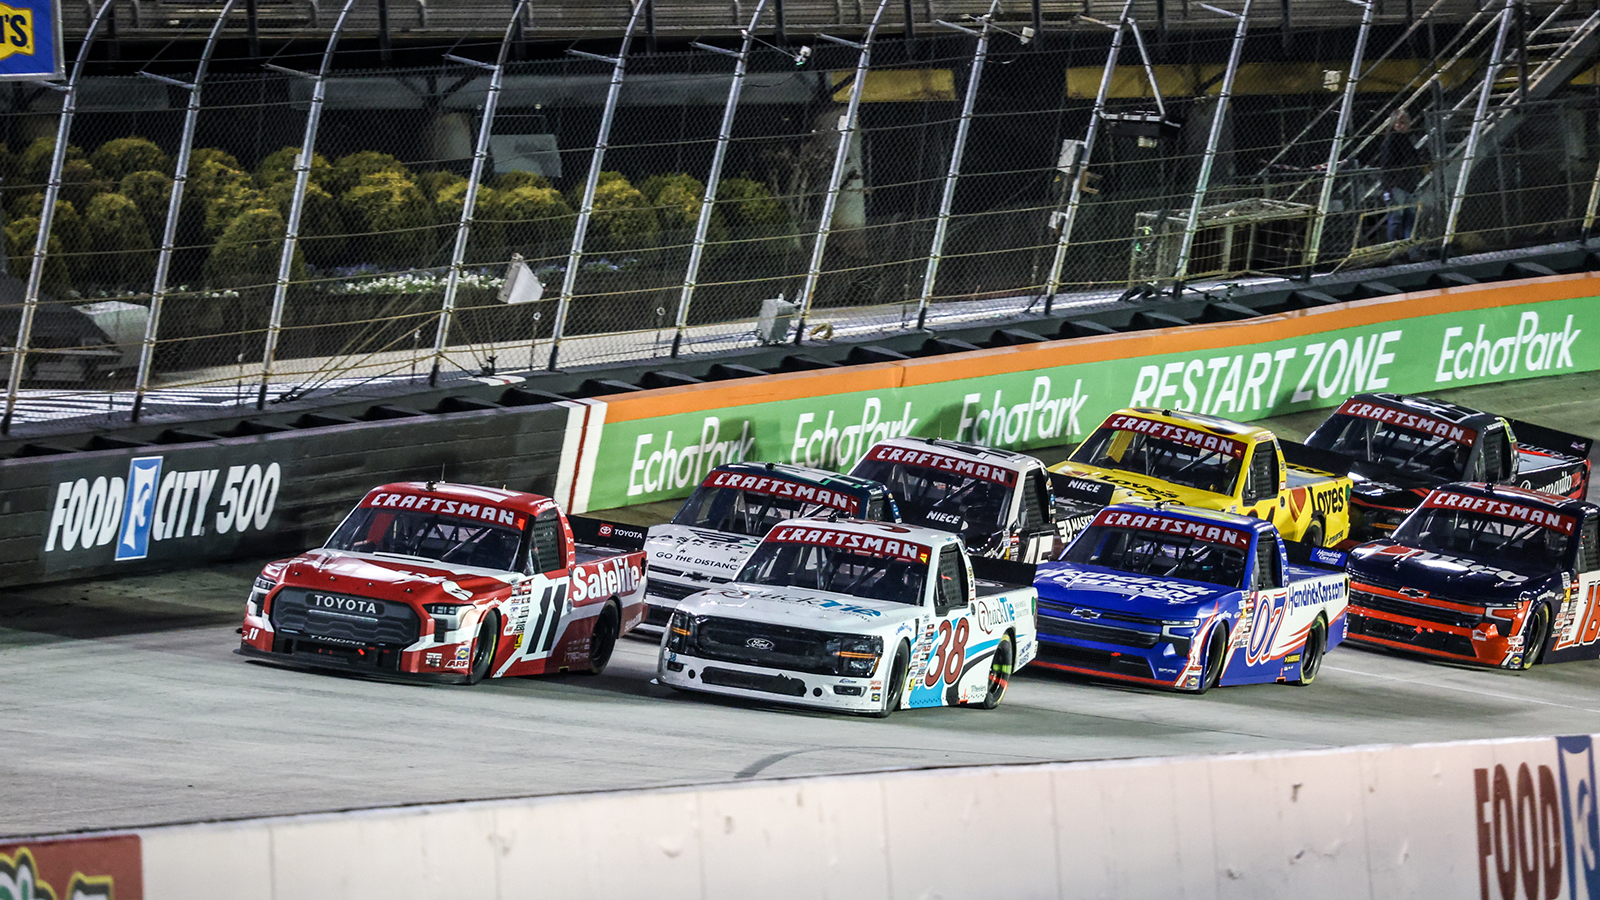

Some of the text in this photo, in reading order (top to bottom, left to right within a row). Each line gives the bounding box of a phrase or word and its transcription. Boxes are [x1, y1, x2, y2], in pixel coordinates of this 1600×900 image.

[0, 14, 27, 47] 'S
[1435, 311, 1581, 382] EchoPark
[1129, 330, 1402, 415] RESTART ZONE
[956, 376, 1088, 446] EchoPark
[1347, 402, 1465, 438] CRAFTSMAN
[791, 397, 919, 467] EchoPark
[1111, 416, 1233, 454] CRAFTSMAN
[627, 416, 755, 496] EchoPark
[876, 447, 1006, 483] CRAFTSMAN
[713, 472, 848, 508] CRAFTSMAN
[1068, 480, 1101, 493] NIECE
[45, 476, 125, 552] FOOD
[153, 470, 220, 541] CITY
[216, 462, 281, 534] 500
[370, 491, 515, 525] CRAFTSMAN
[926, 510, 960, 524] NIECE
[1434, 492, 1561, 526] CRAFTSMAN
[614, 530, 643, 539] TOYOTA
[776, 528, 918, 560] CRAFTSMAN
[1104, 512, 1238, 544] CRAFTSMAN
[572, 557, 640, 601] Safelite
[656, 551, 741, 571] GO THE DISTANC
[314, 595, 376, 614] TOYOTA
[526, 583, 567, 655] 11
[750, 639, 769, 648] Ford
[1248, 591, 1288, 666] 07
[924, 617, 970, 687] 38
[1474, 762, 1562, 900] FOOD
